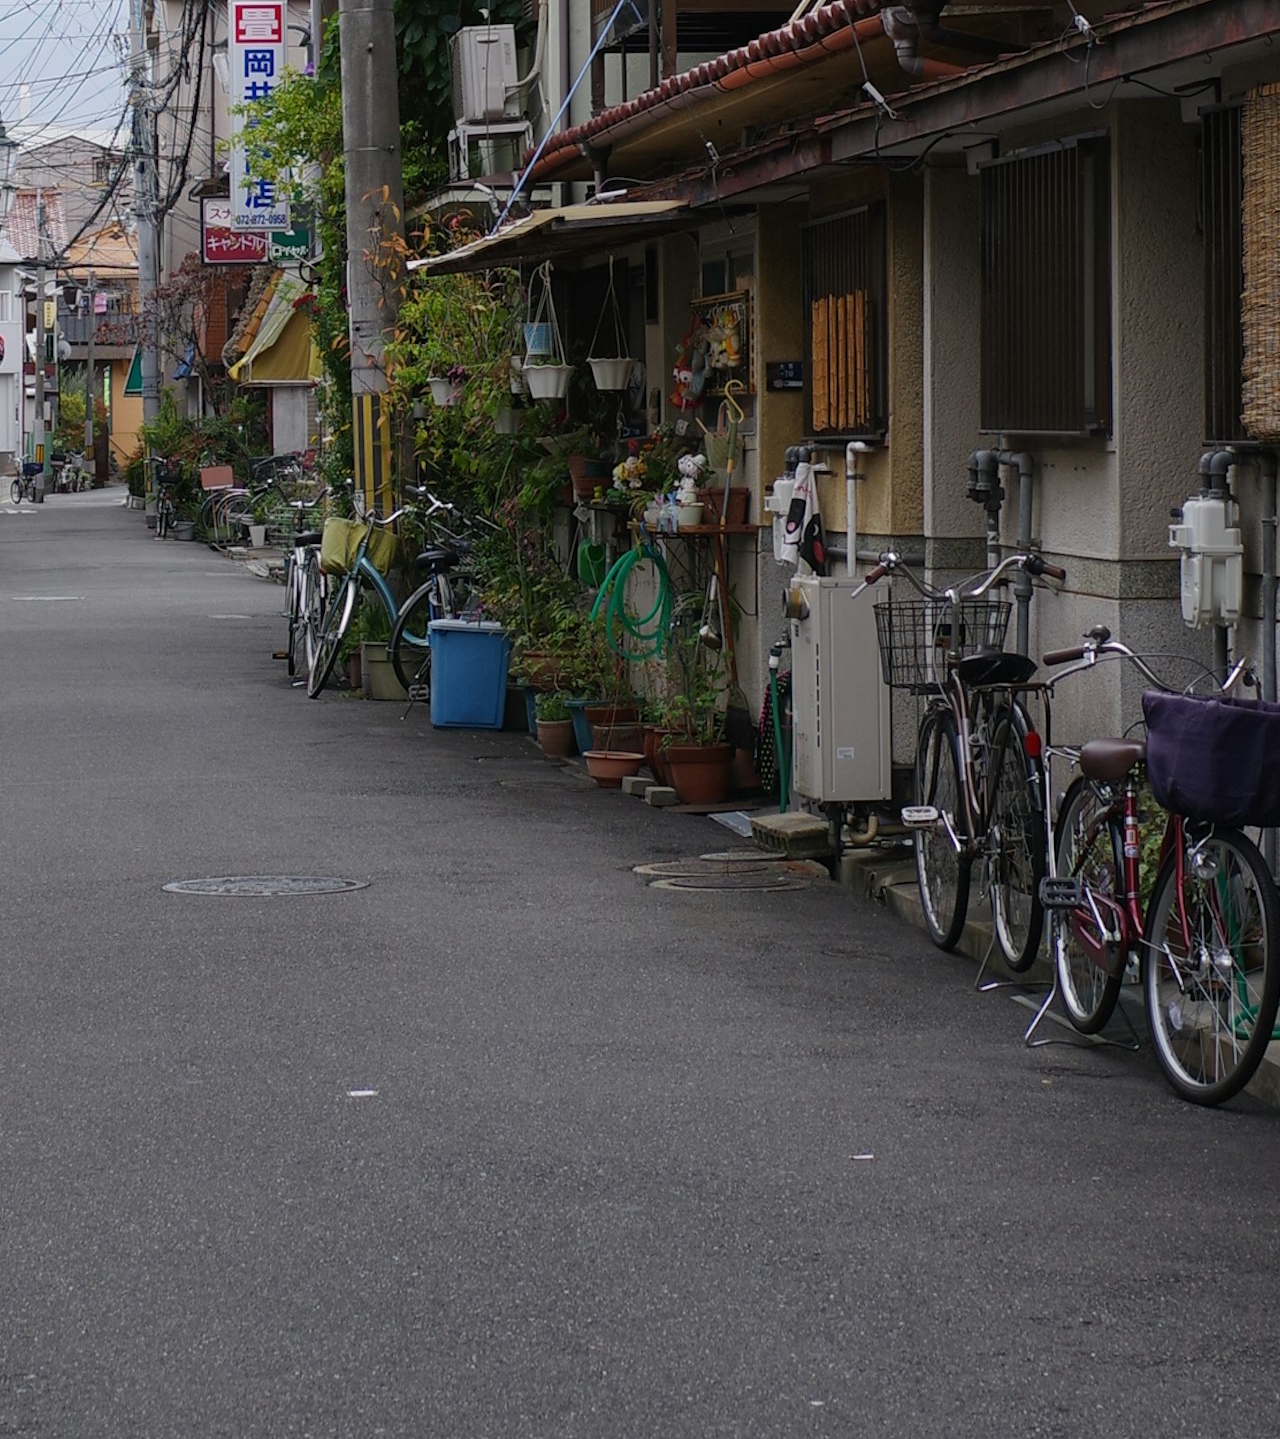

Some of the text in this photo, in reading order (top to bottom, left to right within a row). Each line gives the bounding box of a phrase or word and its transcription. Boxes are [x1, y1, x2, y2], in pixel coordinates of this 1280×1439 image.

[244, 49, 276, 209] 岡井店
[236, 214, 287, 225] 072-872-0958
